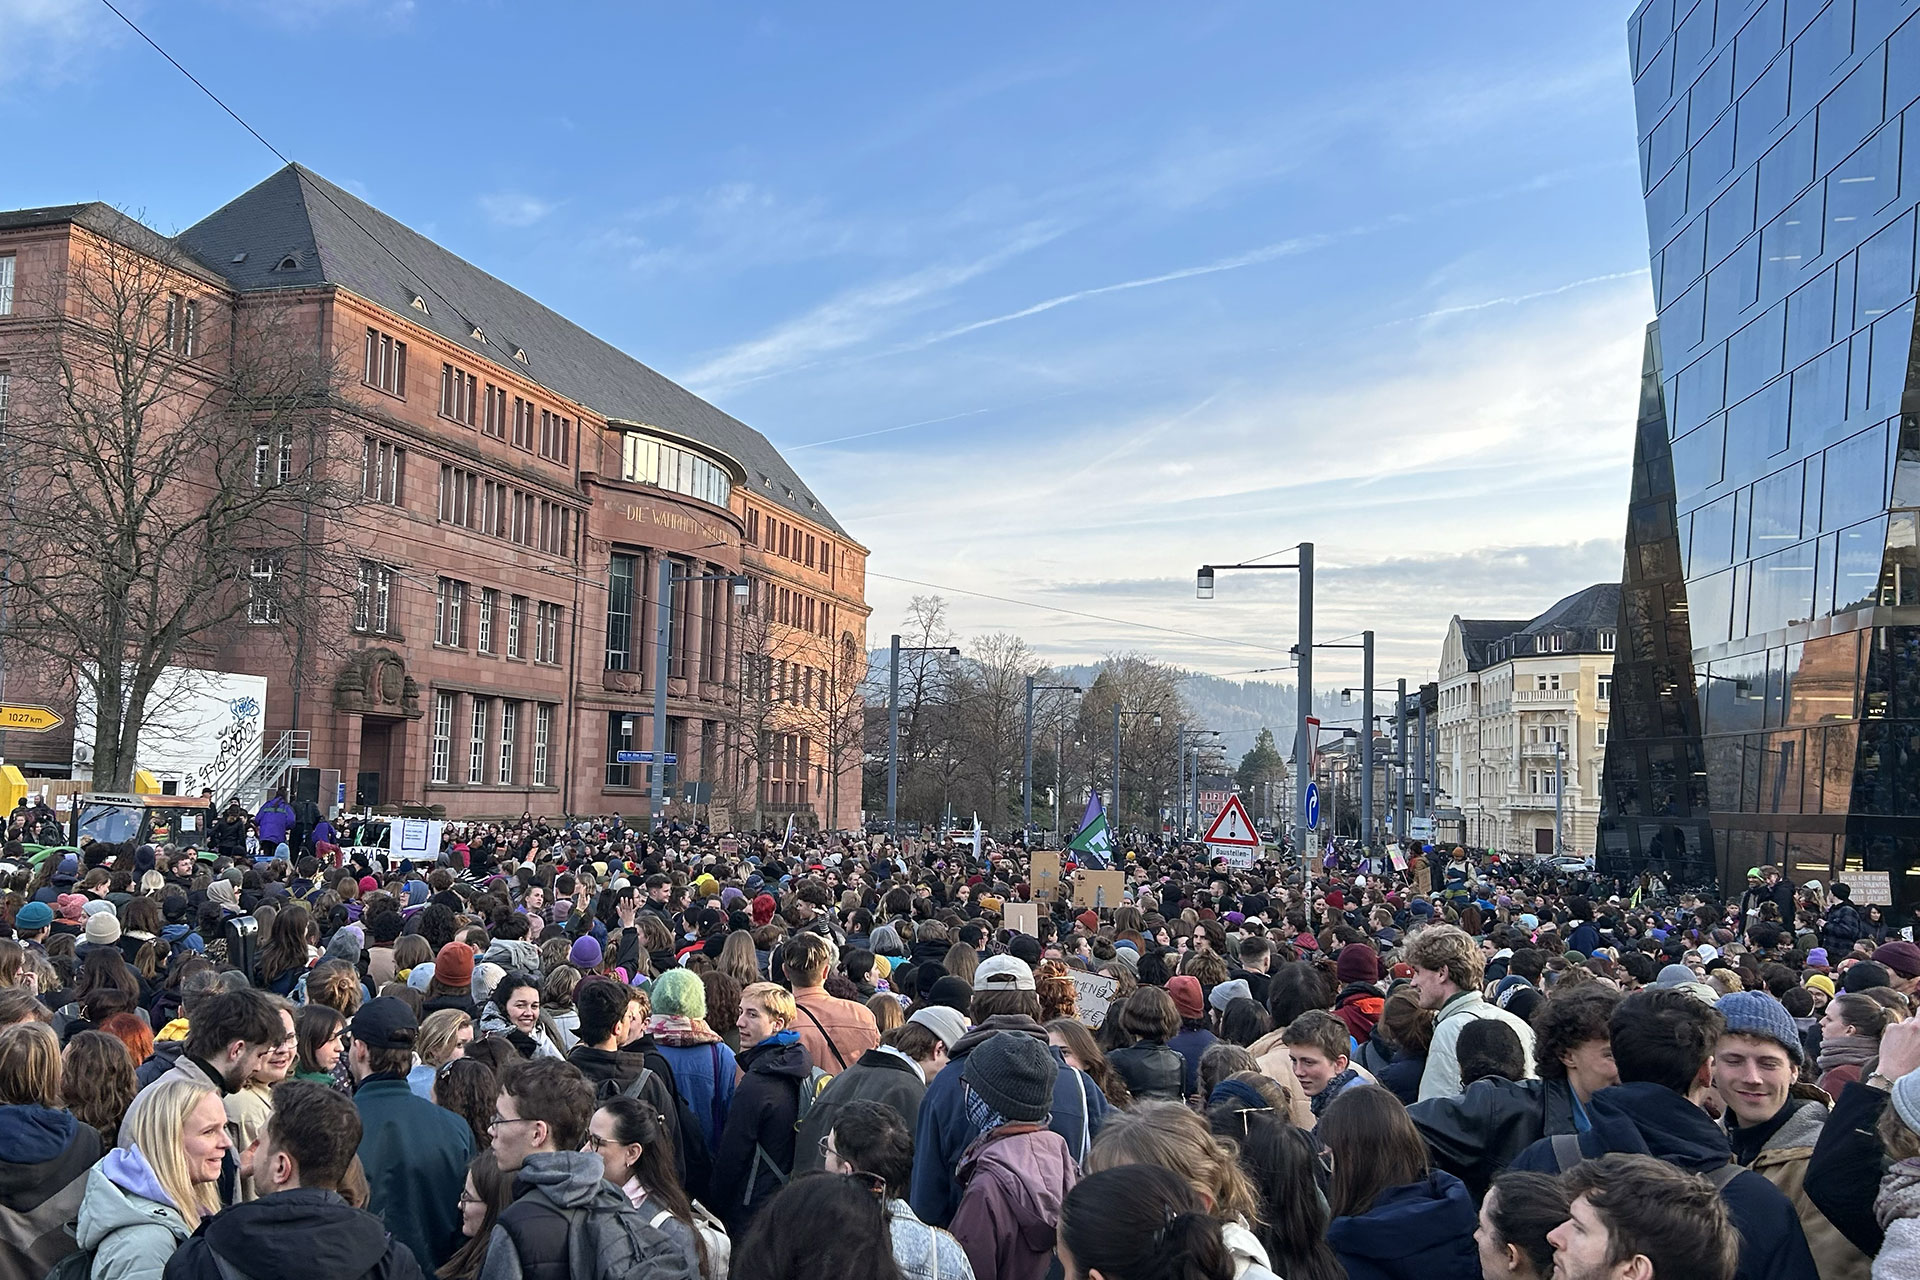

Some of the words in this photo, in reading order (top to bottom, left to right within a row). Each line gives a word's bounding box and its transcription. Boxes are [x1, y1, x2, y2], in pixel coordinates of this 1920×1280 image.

[627, 504, 648, 523] DIE
[9, 713, 30, 722] 1027
[94, 795, 133, 803] SPECIAL
[1216, 848, 1250, 857] Baustellen-
